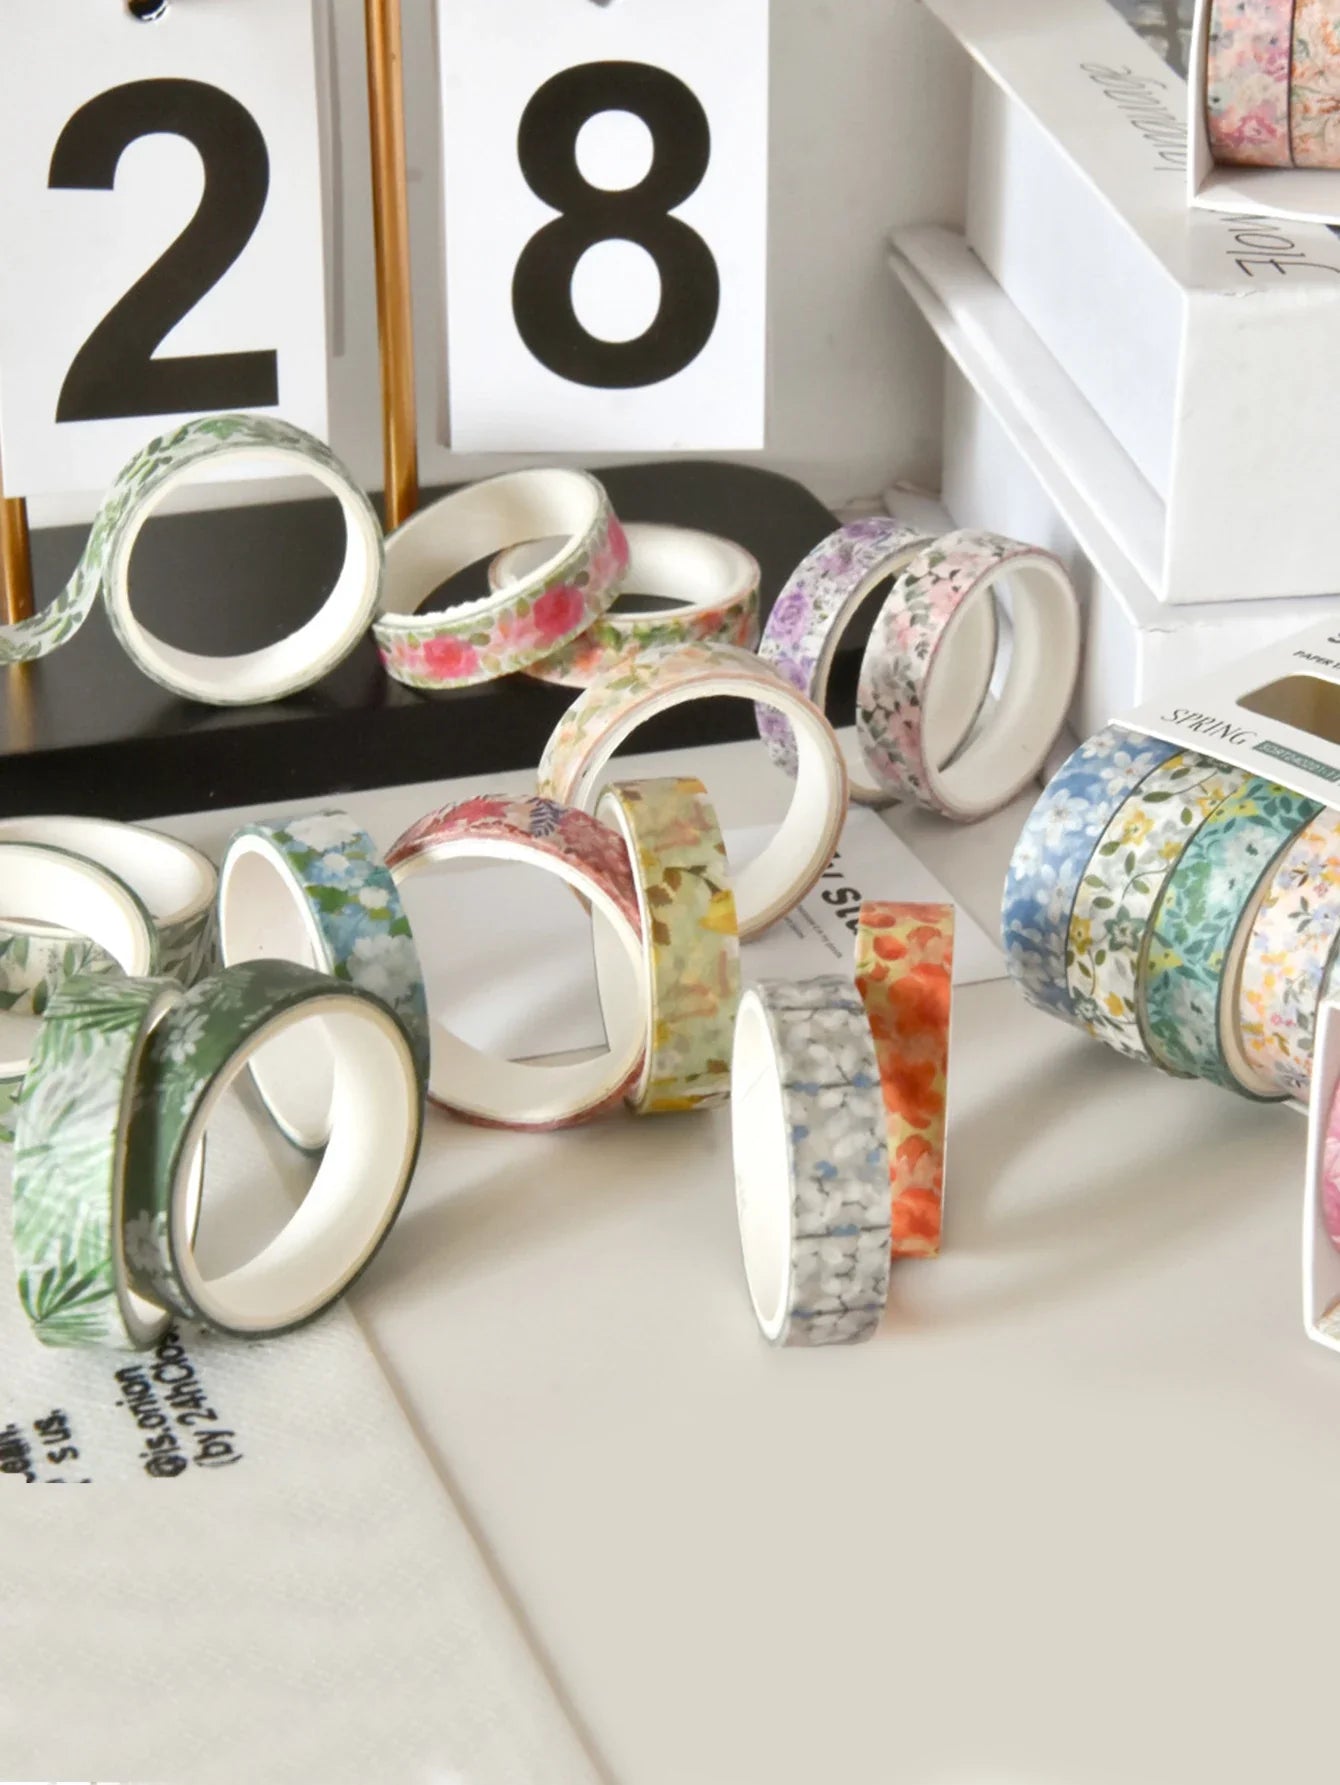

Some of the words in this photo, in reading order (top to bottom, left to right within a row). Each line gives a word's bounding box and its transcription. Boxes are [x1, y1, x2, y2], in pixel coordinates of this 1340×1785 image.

[48, 77, 279, 424] 2
[511, 60, 720, 389] 8
[1160, 707, 1257, 746] SPRING
